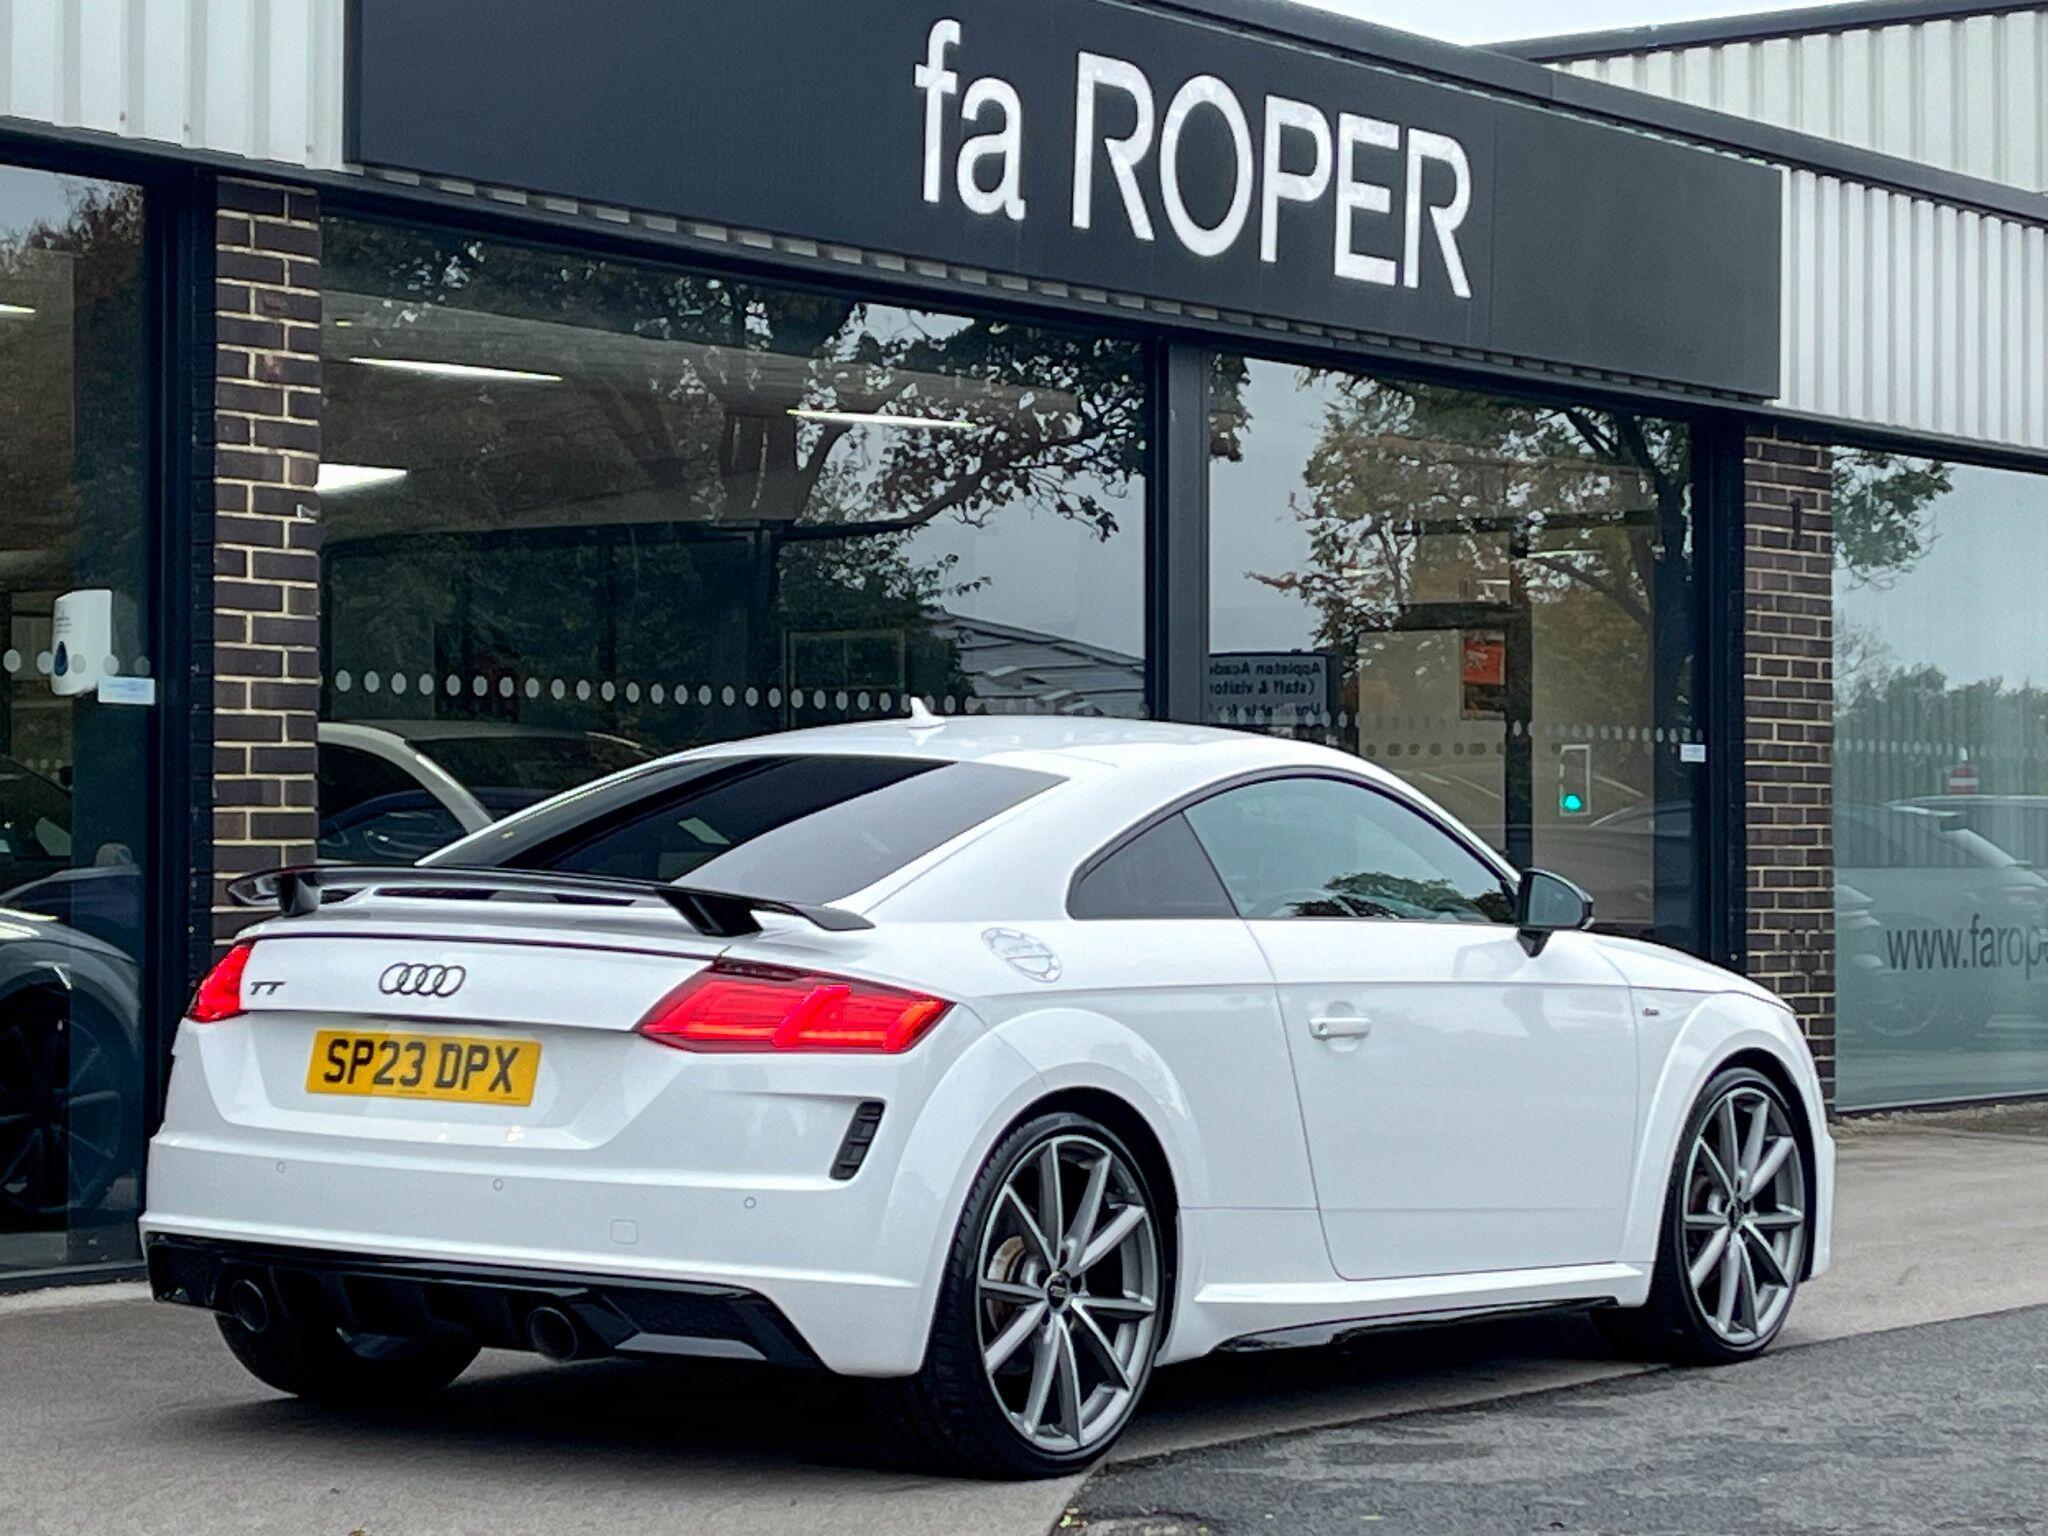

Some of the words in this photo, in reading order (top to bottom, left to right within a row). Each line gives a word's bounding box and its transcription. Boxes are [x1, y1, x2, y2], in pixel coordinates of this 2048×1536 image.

[914, 19, 1026, 221] fa
[1072, 50, 1472, 299] ROPER
[250, 981, 285, 995] TT
[323, 1038, 426, 1087] SP23
[434, 1043, 519, 1093] DPX
